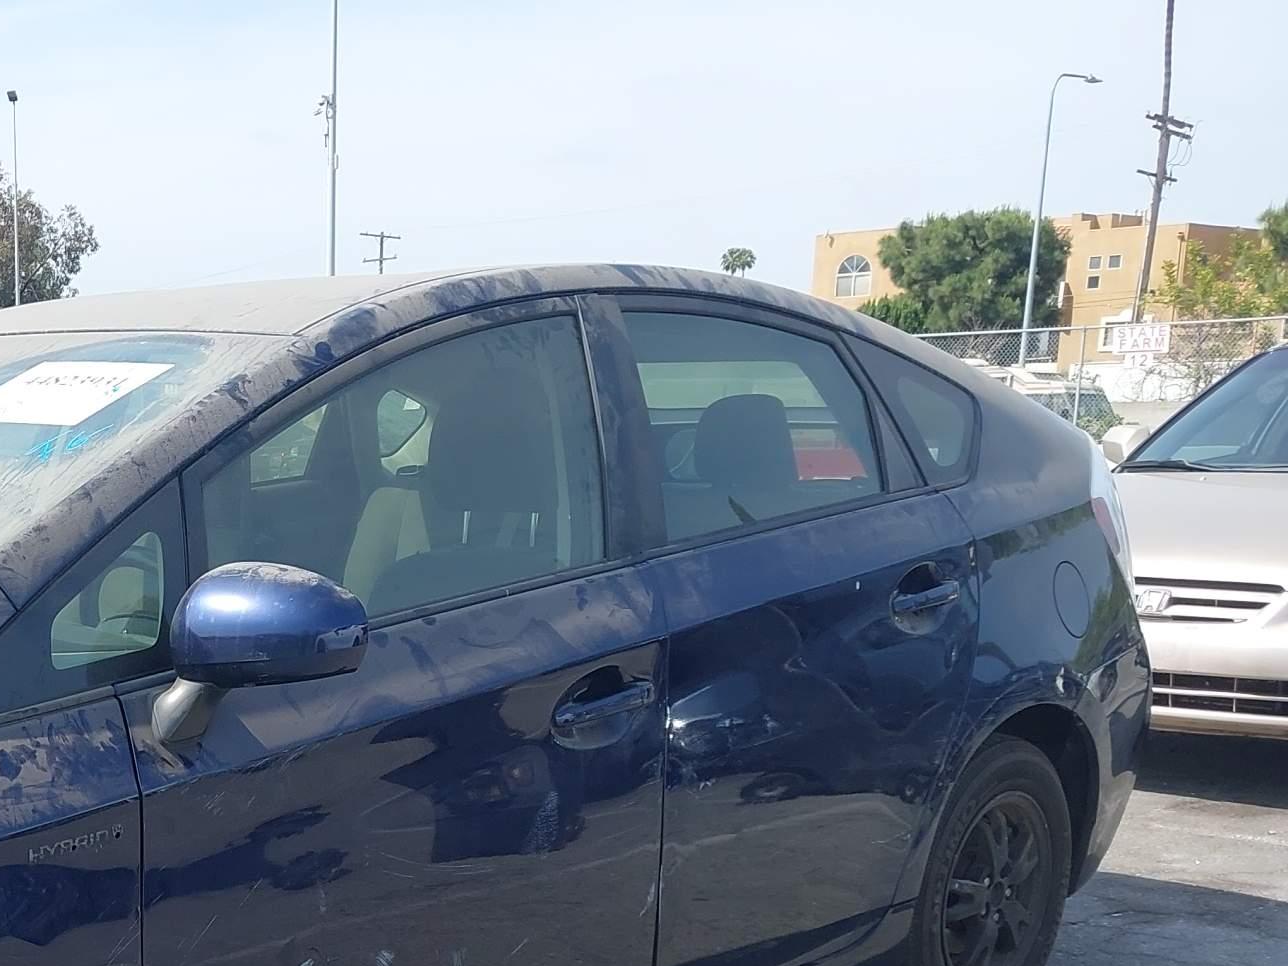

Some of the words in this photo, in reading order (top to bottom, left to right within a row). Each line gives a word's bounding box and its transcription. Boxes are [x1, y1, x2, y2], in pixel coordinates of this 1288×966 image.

[1118, 325, 1168, 338] STATE
[1119, 337, 1165, 350] FARM
[1130, 354, 1148, 368] 12
